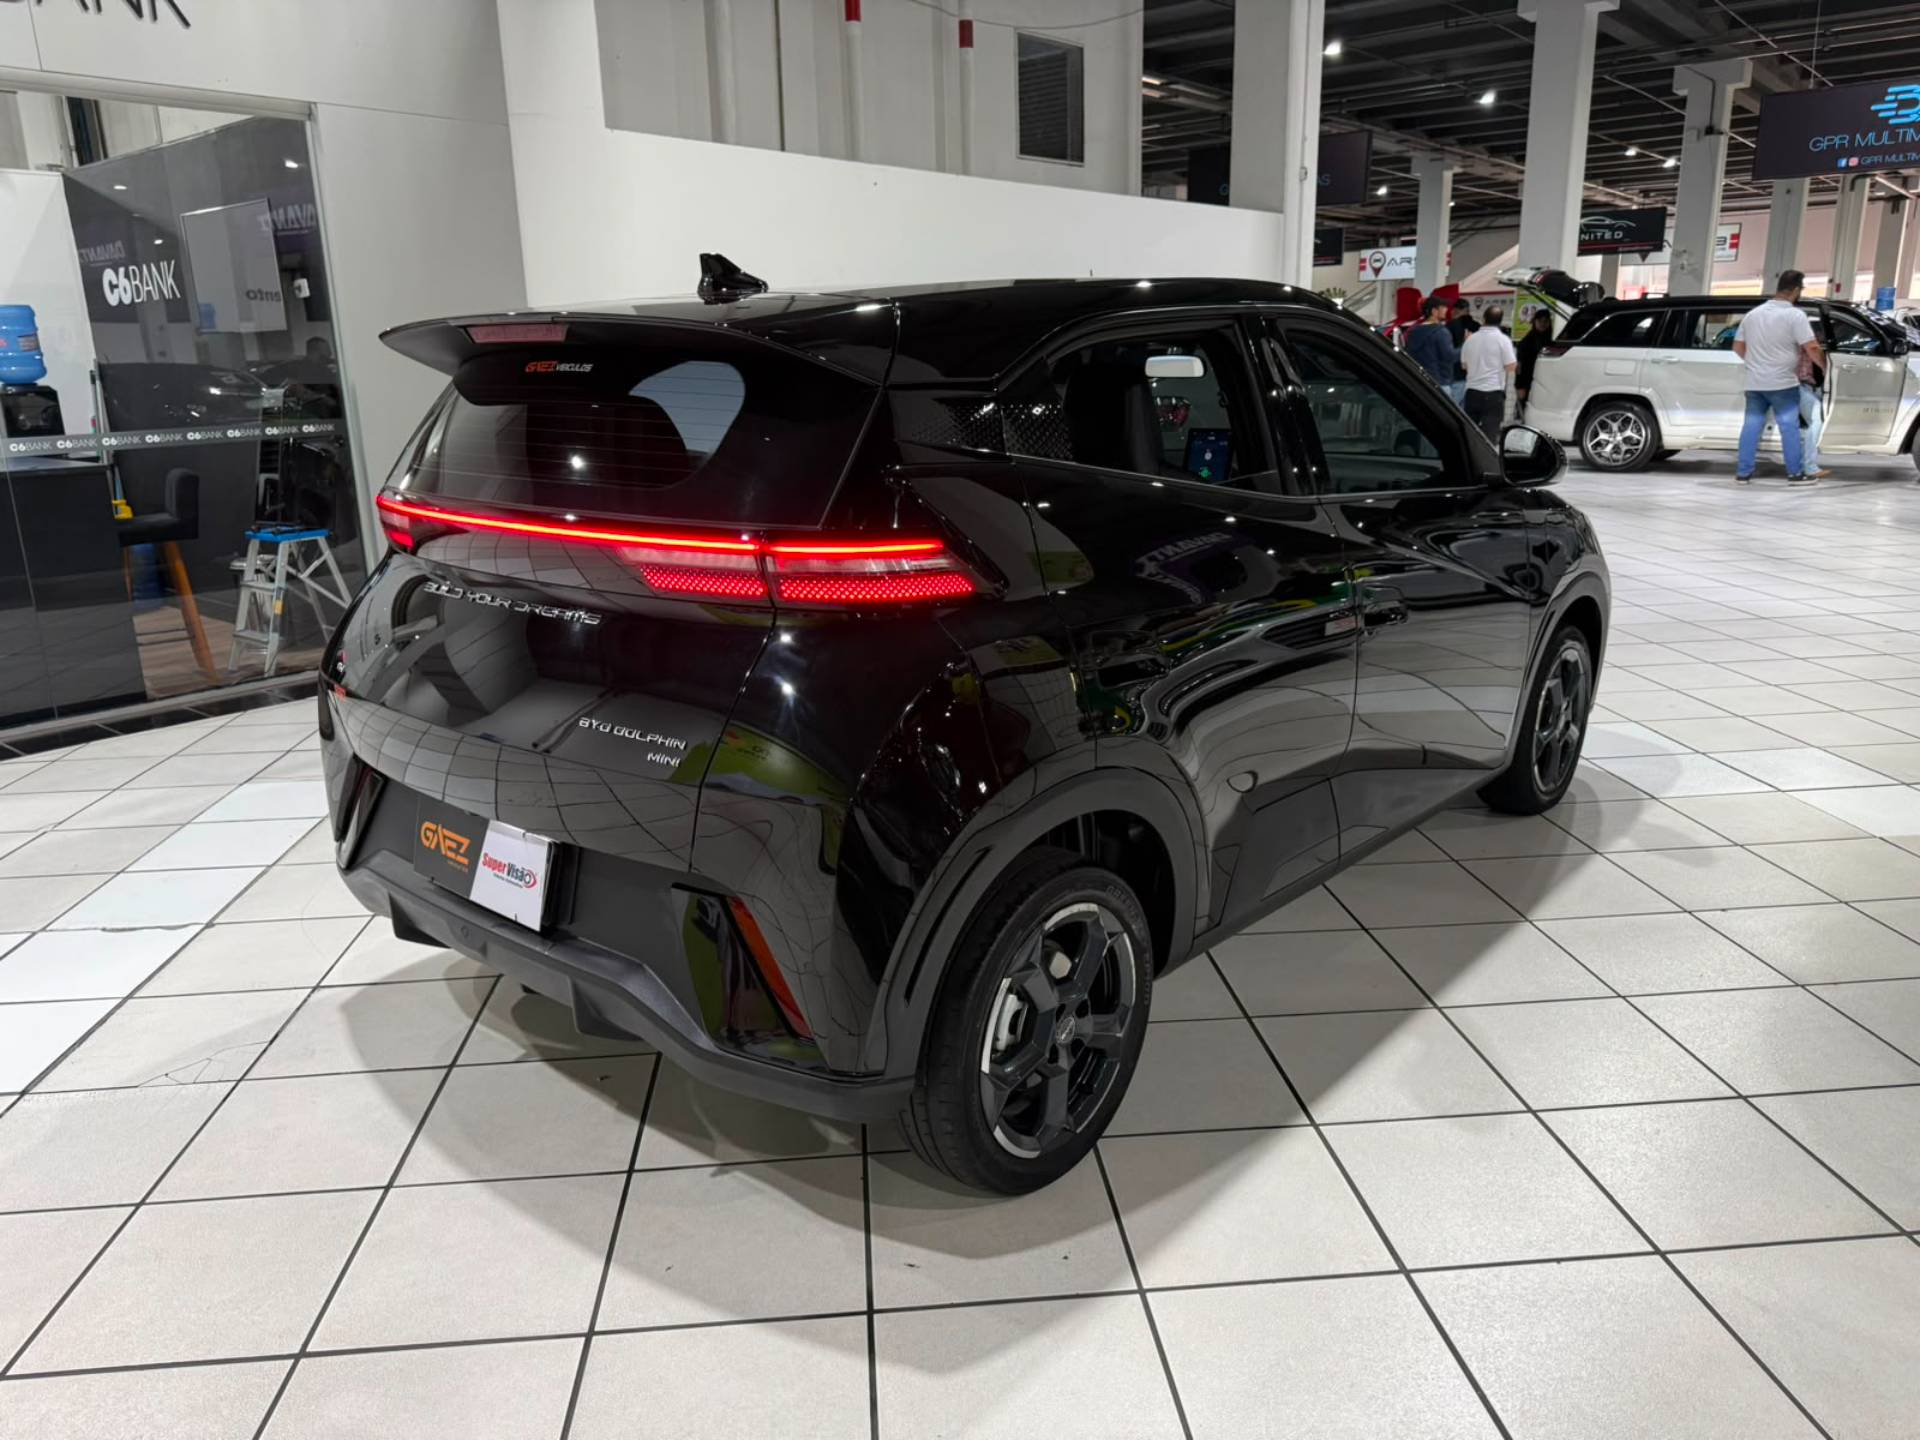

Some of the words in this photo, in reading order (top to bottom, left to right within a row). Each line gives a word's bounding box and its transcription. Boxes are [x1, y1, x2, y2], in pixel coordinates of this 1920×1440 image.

[1808, 134, 1850, 152] GPR
[1580, 231, 1624, 241] NITED
[102, 259, 181, 306] C6BANK
[9, 442, 52, 452] C6BANK
[56, 438, 98, 449] C6BANK
[102, 435, 142, 446] C6BANK
[145, 433, 184, 443] C6BANK
[186, 430, 224, 440] C6BANK
[226, 427, 263, 438] C6BANK
[265, 425, 300, 435] C6BANK
[302, 423, 335, 433] C6BANK
[424, 580, 464, 599] BUILD
[466, 591, 511, 609] YOUR
[514, 601, 602, 625] DREAMS
[579, 716, 612, 733] BYD
[613, 726, 687, 750] DOLPHIN
[647, 752, 681, 768] MINI
[482, 852, 507, 874] Super
